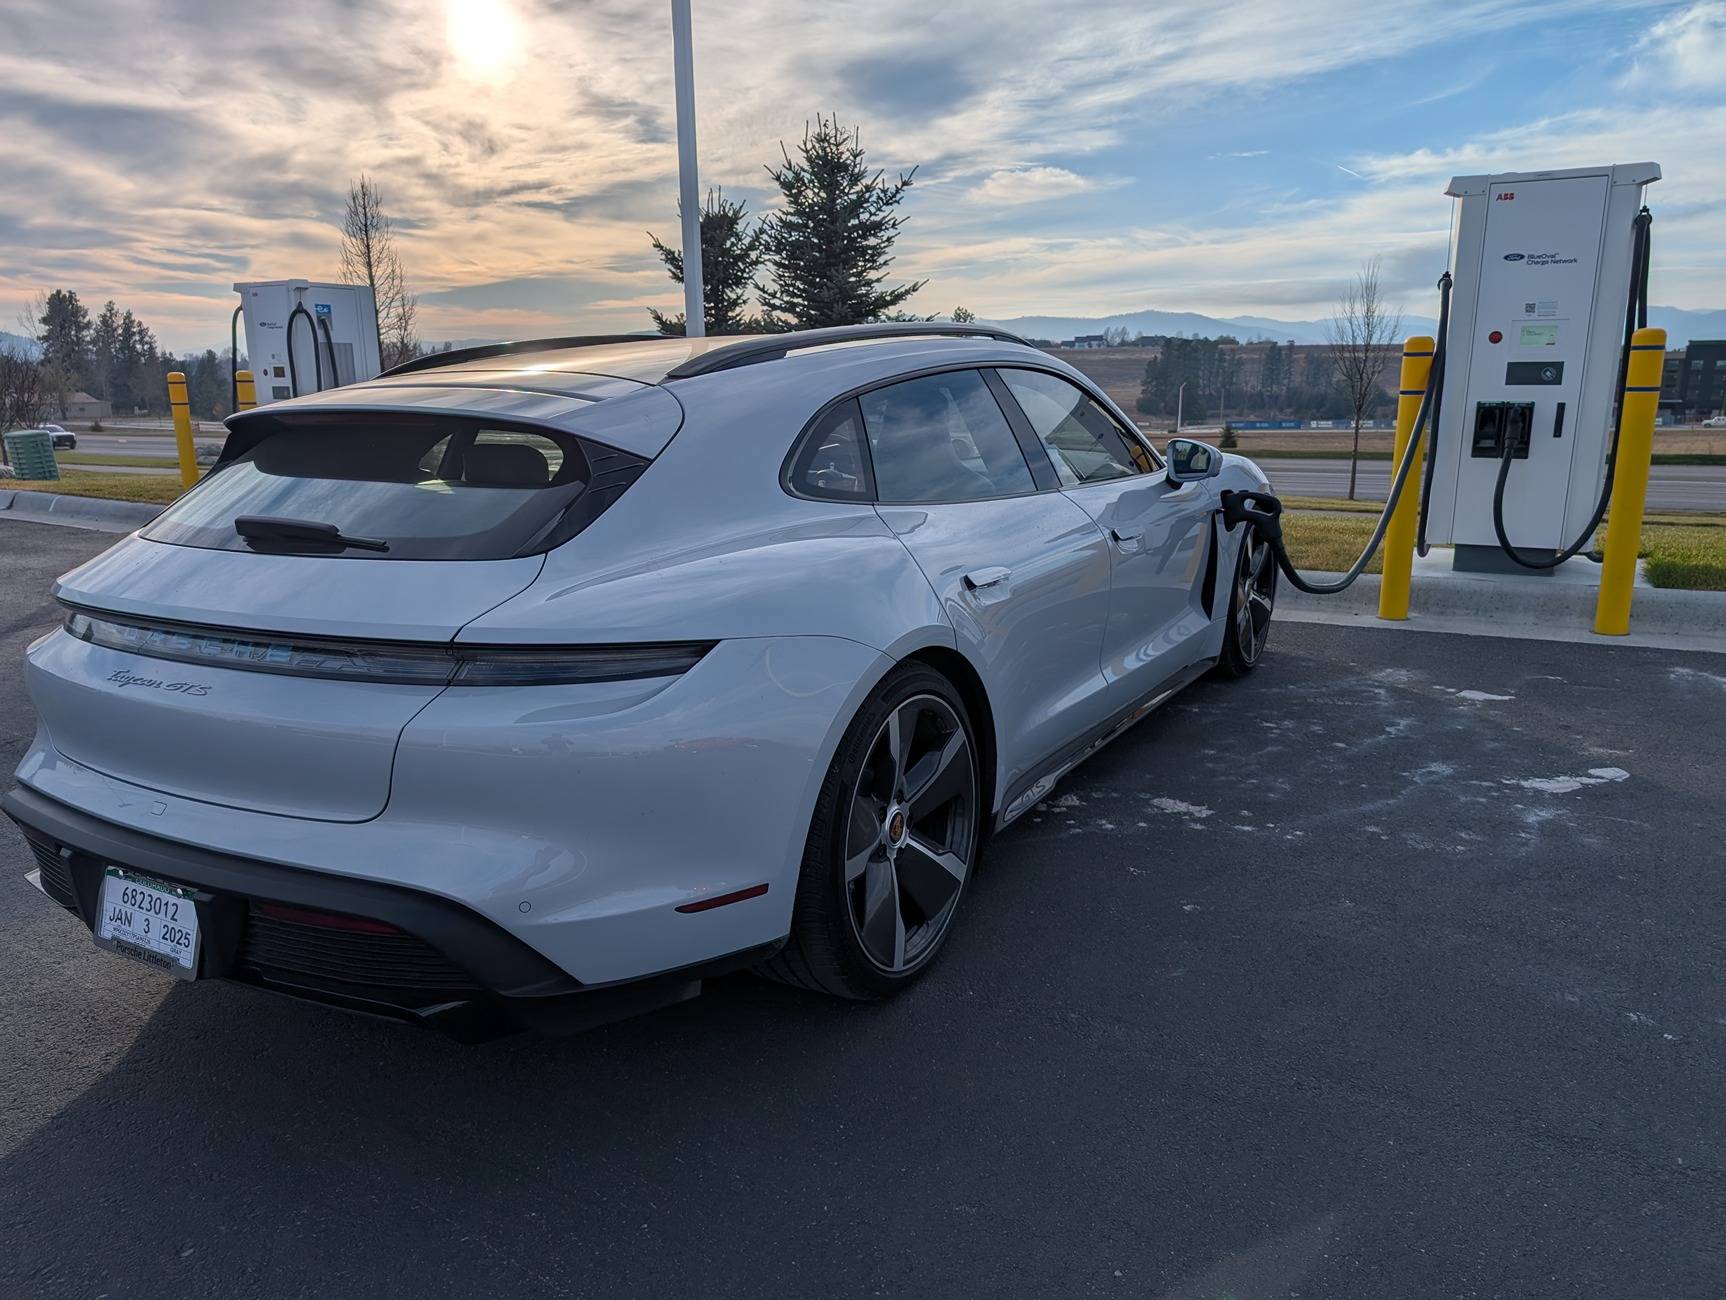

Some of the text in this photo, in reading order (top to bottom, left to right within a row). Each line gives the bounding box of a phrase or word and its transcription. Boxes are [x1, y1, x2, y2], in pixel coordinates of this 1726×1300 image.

[1496, 193, 1514, 201] ABB
[1550, 257, 1577, 265] Network
[107, 669, 213, 696] Taycan GTS
[122, 886, 179, 923] 6823012
[109, 906, 133, 928] JAN
[143, 918, 150, 935] 3
[161, 924, 191, 949] 2025
[116, 941, 172, 970] Porsche Littleton
